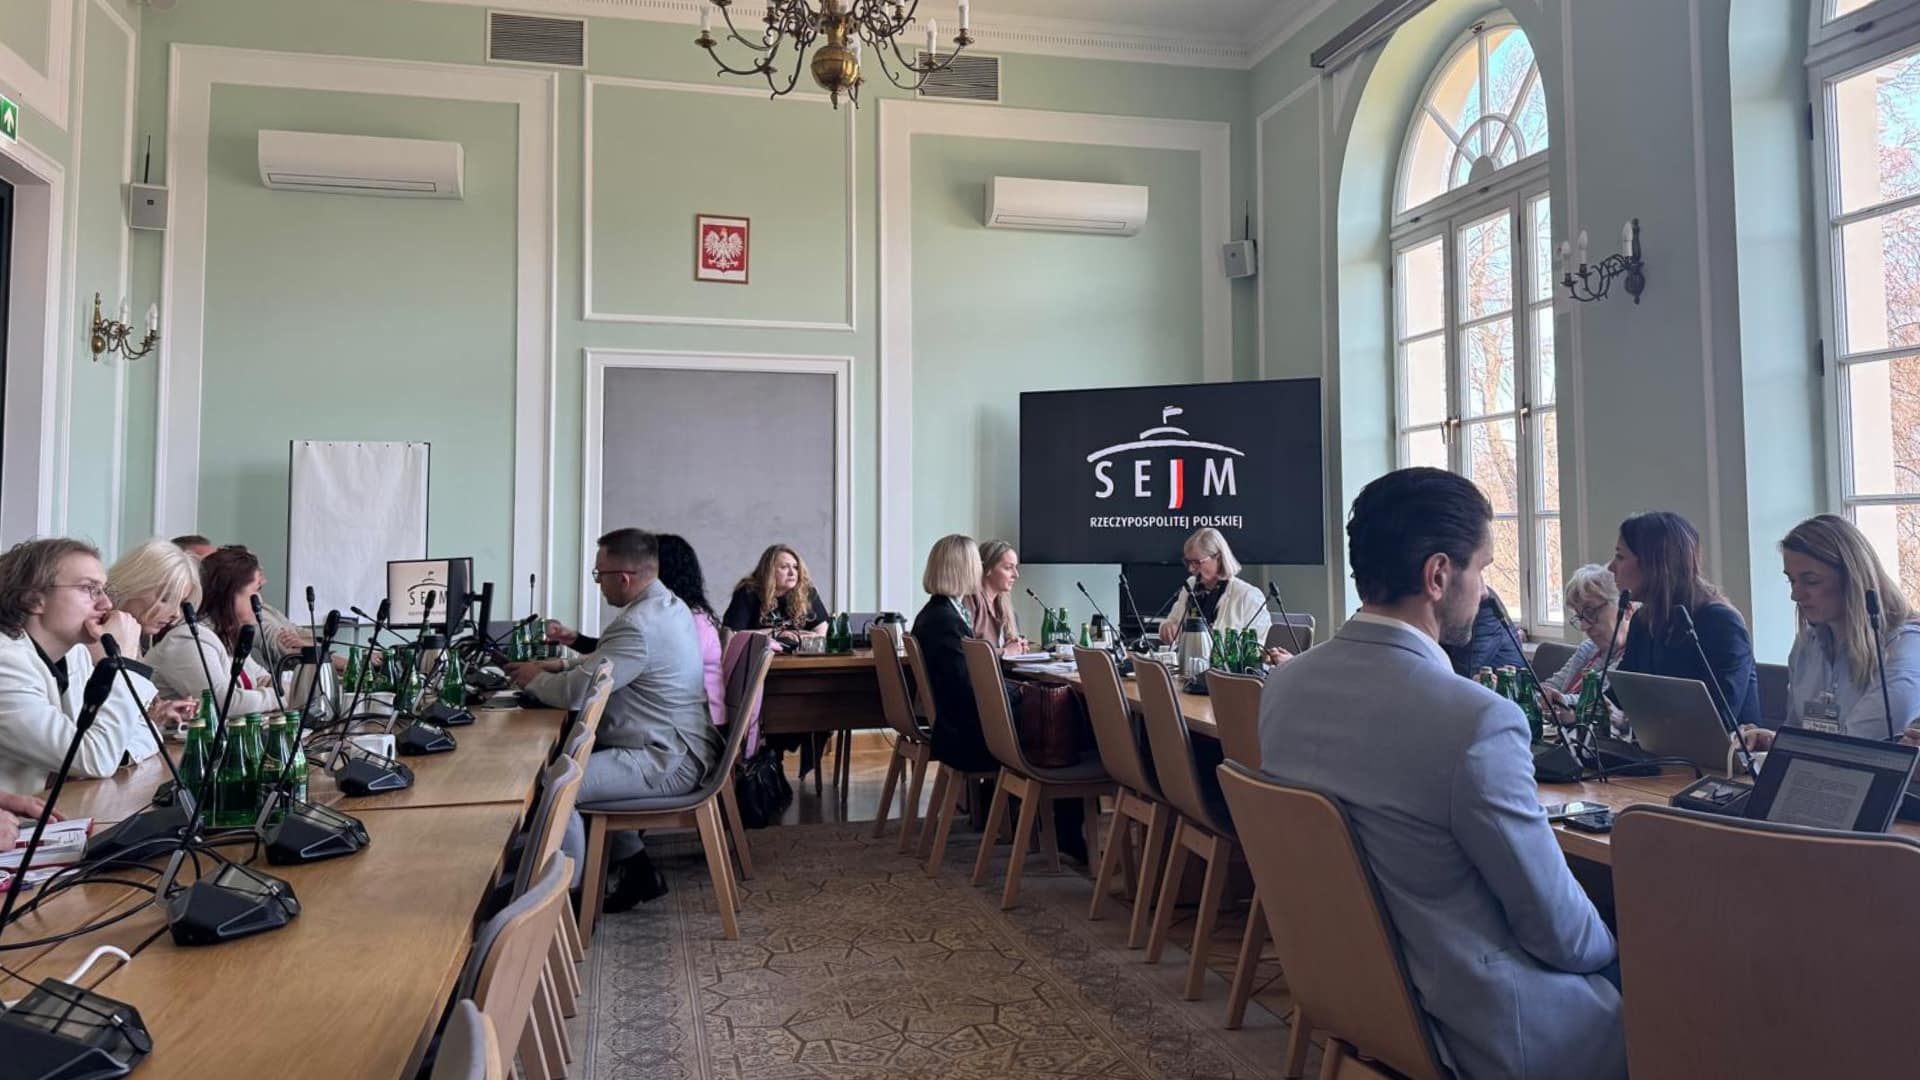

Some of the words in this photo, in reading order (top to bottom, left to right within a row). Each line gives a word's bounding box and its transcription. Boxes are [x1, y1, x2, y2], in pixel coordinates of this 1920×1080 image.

[1095, 458, 1237, 509] SEJM
[1090, 516, 1189, 529] RZECZYPOSPOLITEJ
[1193, 515, 1242, 528] POLSKIEJ
[409, 591, 447, 605] SEM
